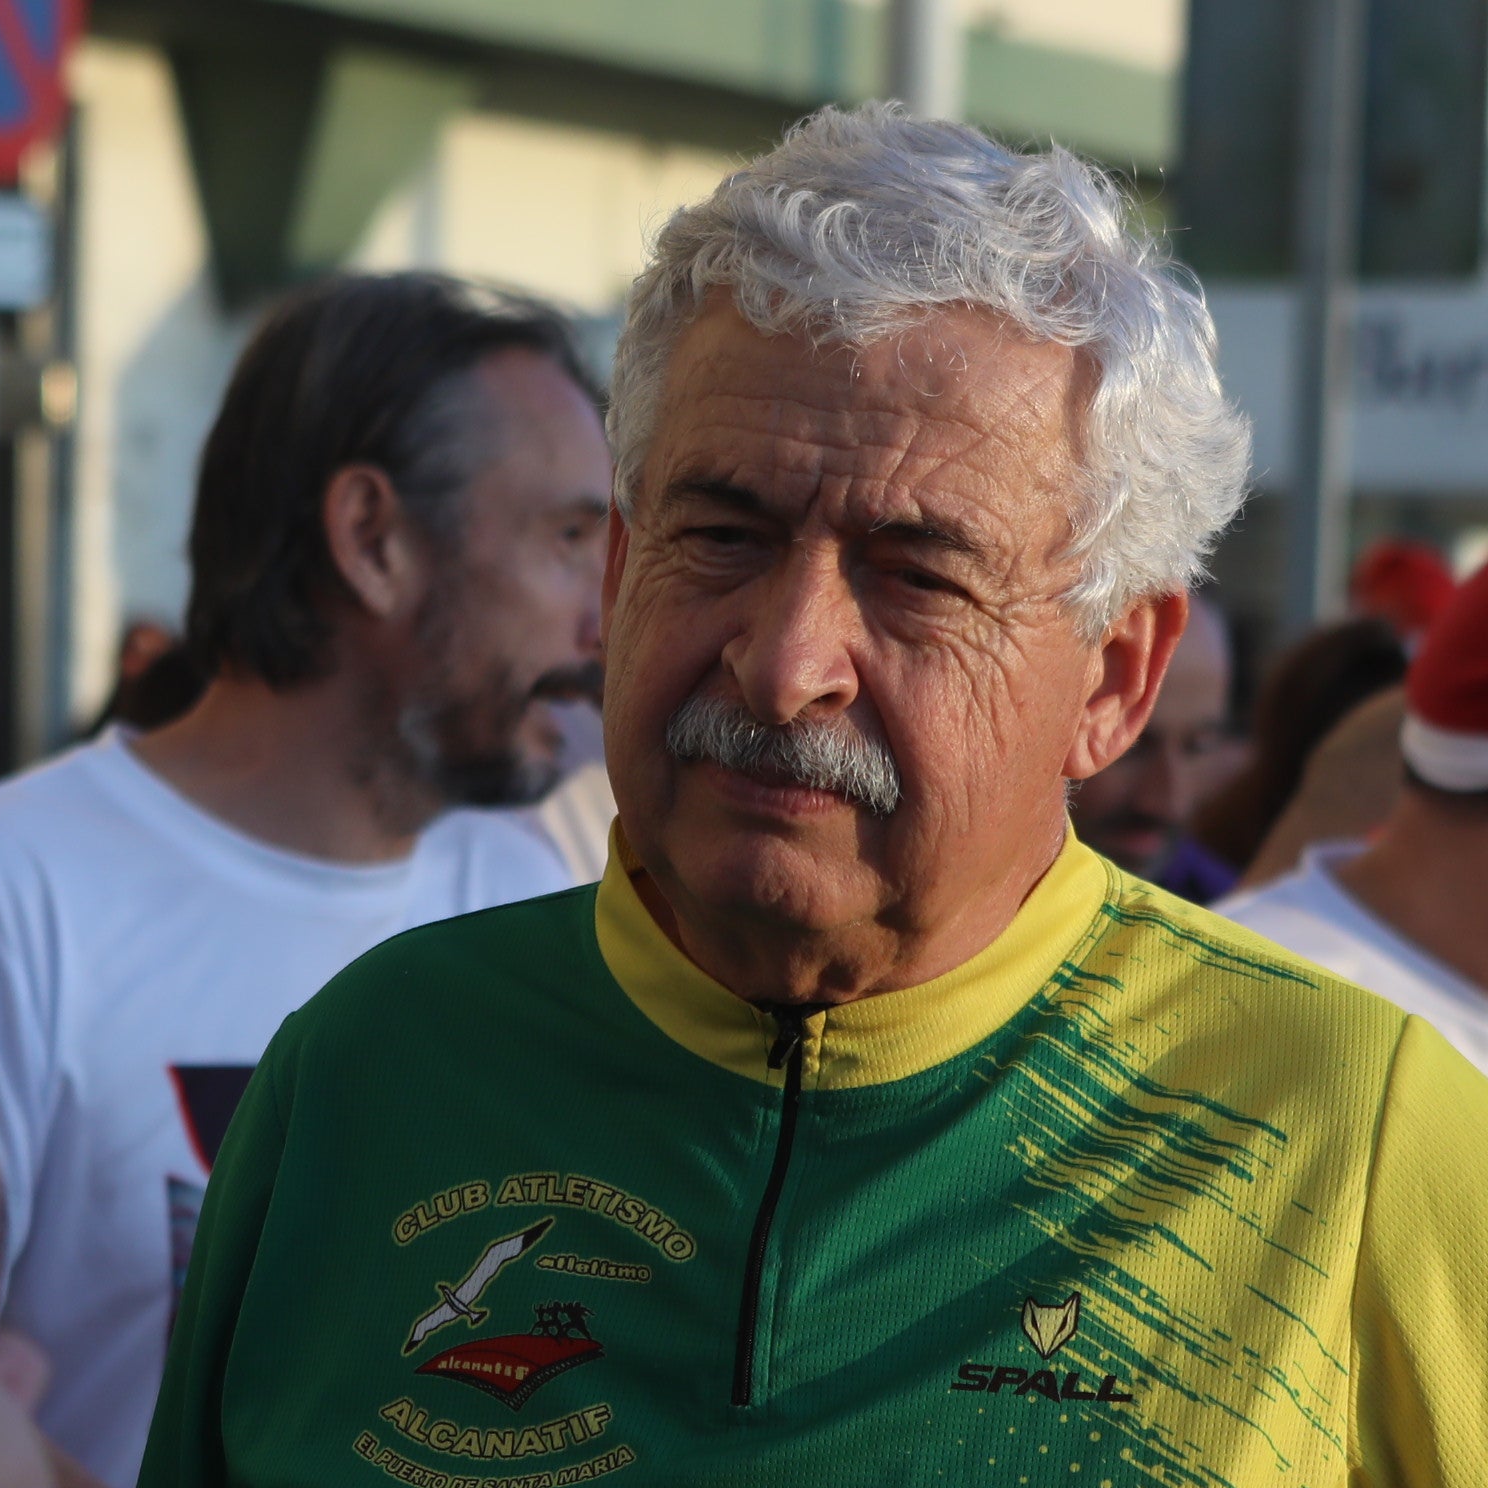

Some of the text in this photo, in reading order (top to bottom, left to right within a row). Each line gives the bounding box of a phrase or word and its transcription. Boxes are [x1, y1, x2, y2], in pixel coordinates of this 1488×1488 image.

[393, 1174, 696, 1261] CLUB ATLETISMO
[535, 1255, 651, 1281] atletismo
[951, 1364, 1133, 1403] SPALL
[380, 1398, 611, 1458] ALCANATIF
[354, 1433, 376, 1459] EL
[557, 1445, 635, 1484] MARIA
